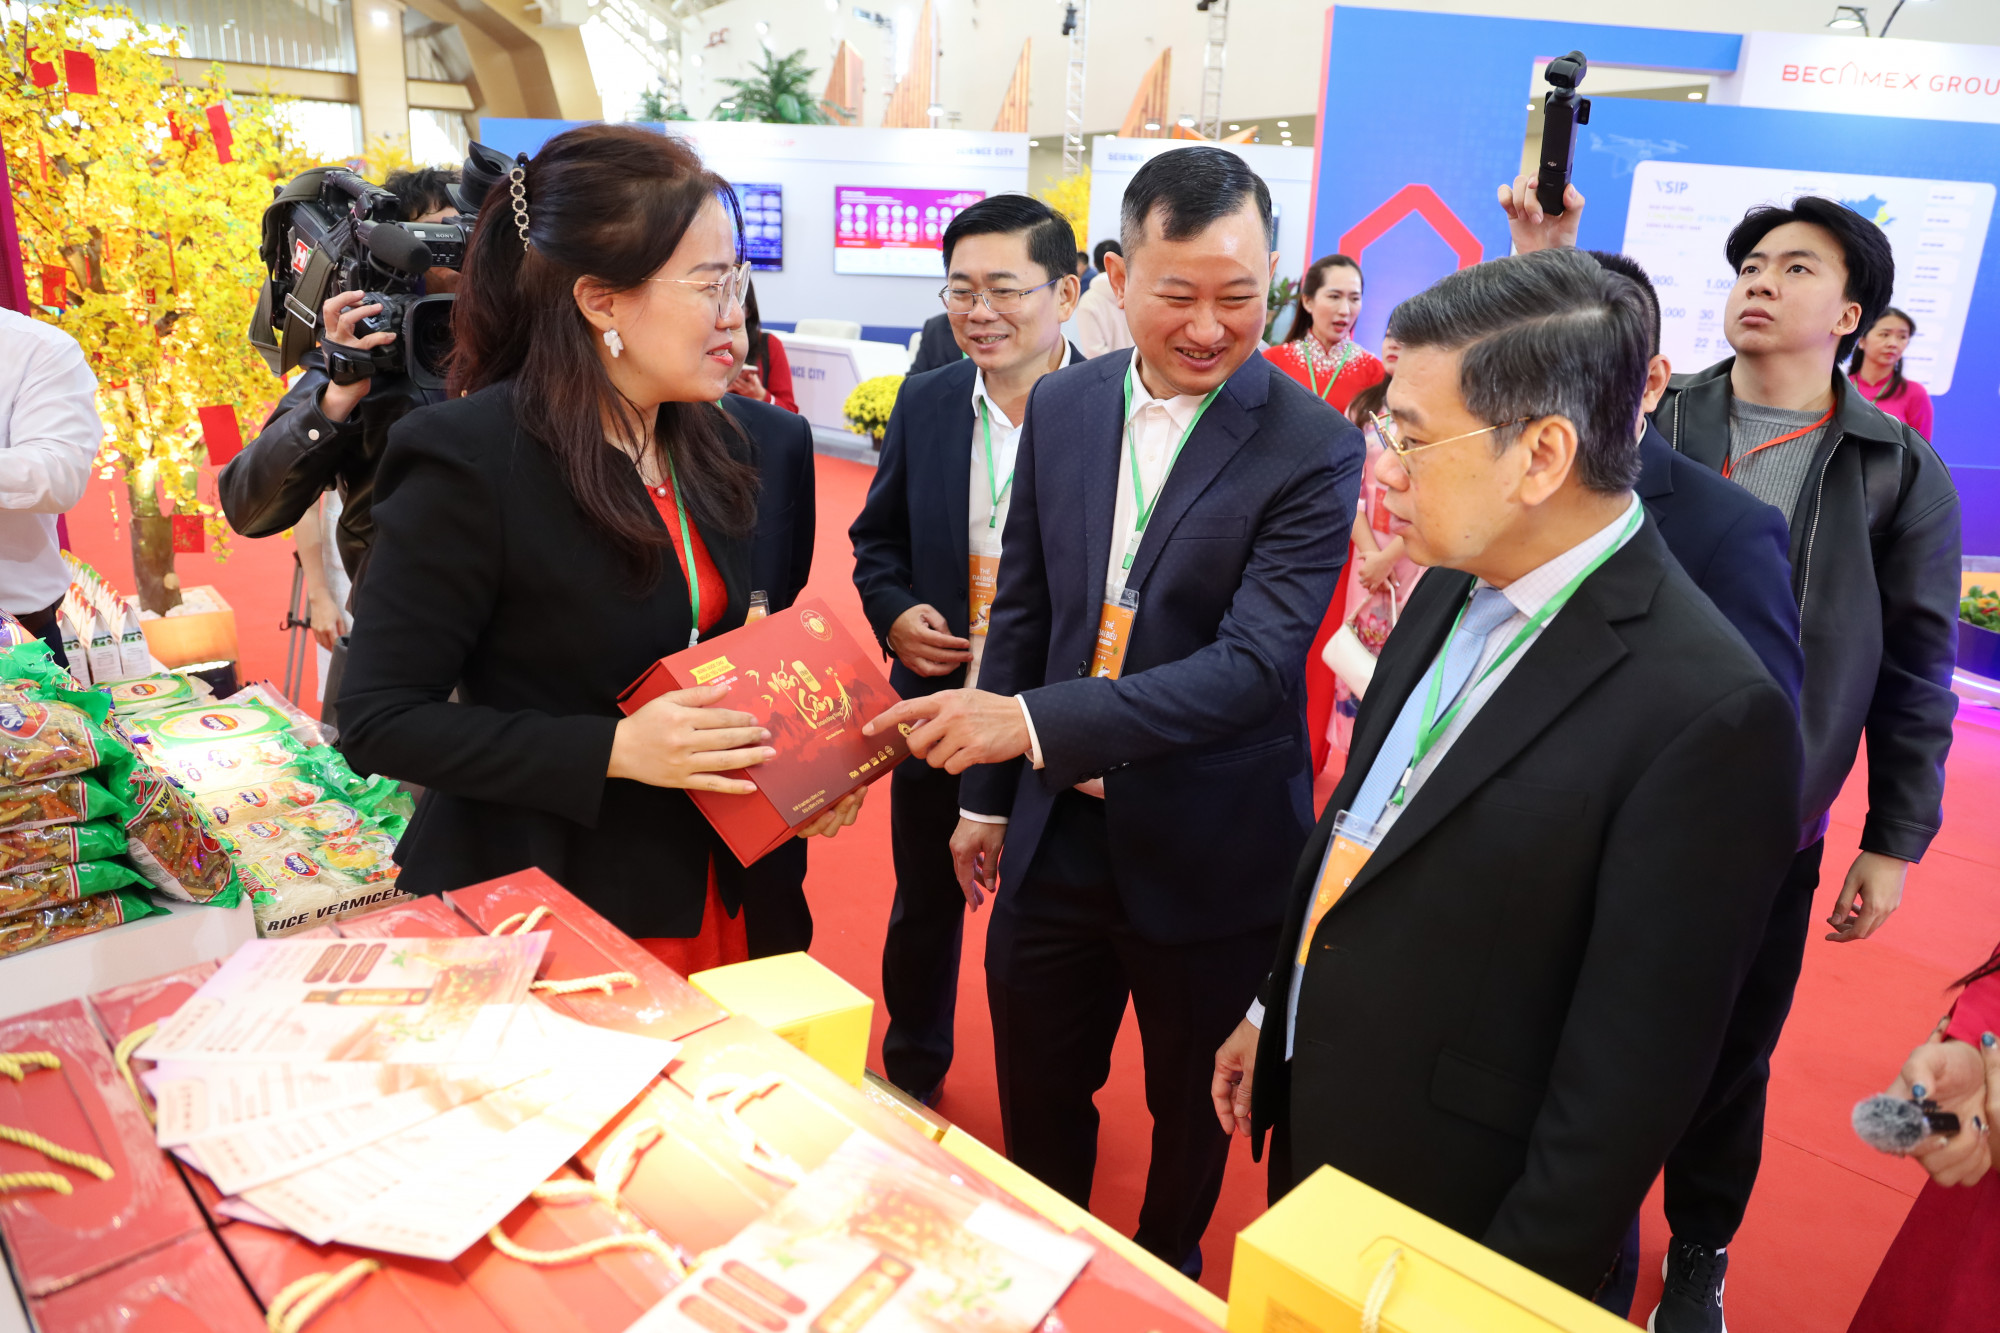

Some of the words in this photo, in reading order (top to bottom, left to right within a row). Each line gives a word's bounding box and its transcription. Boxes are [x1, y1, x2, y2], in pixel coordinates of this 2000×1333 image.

[1929, 74, 2000, 96] GROU
[155, 791, 171, 809] VEG
[267, 912, 309, 932] RICE
